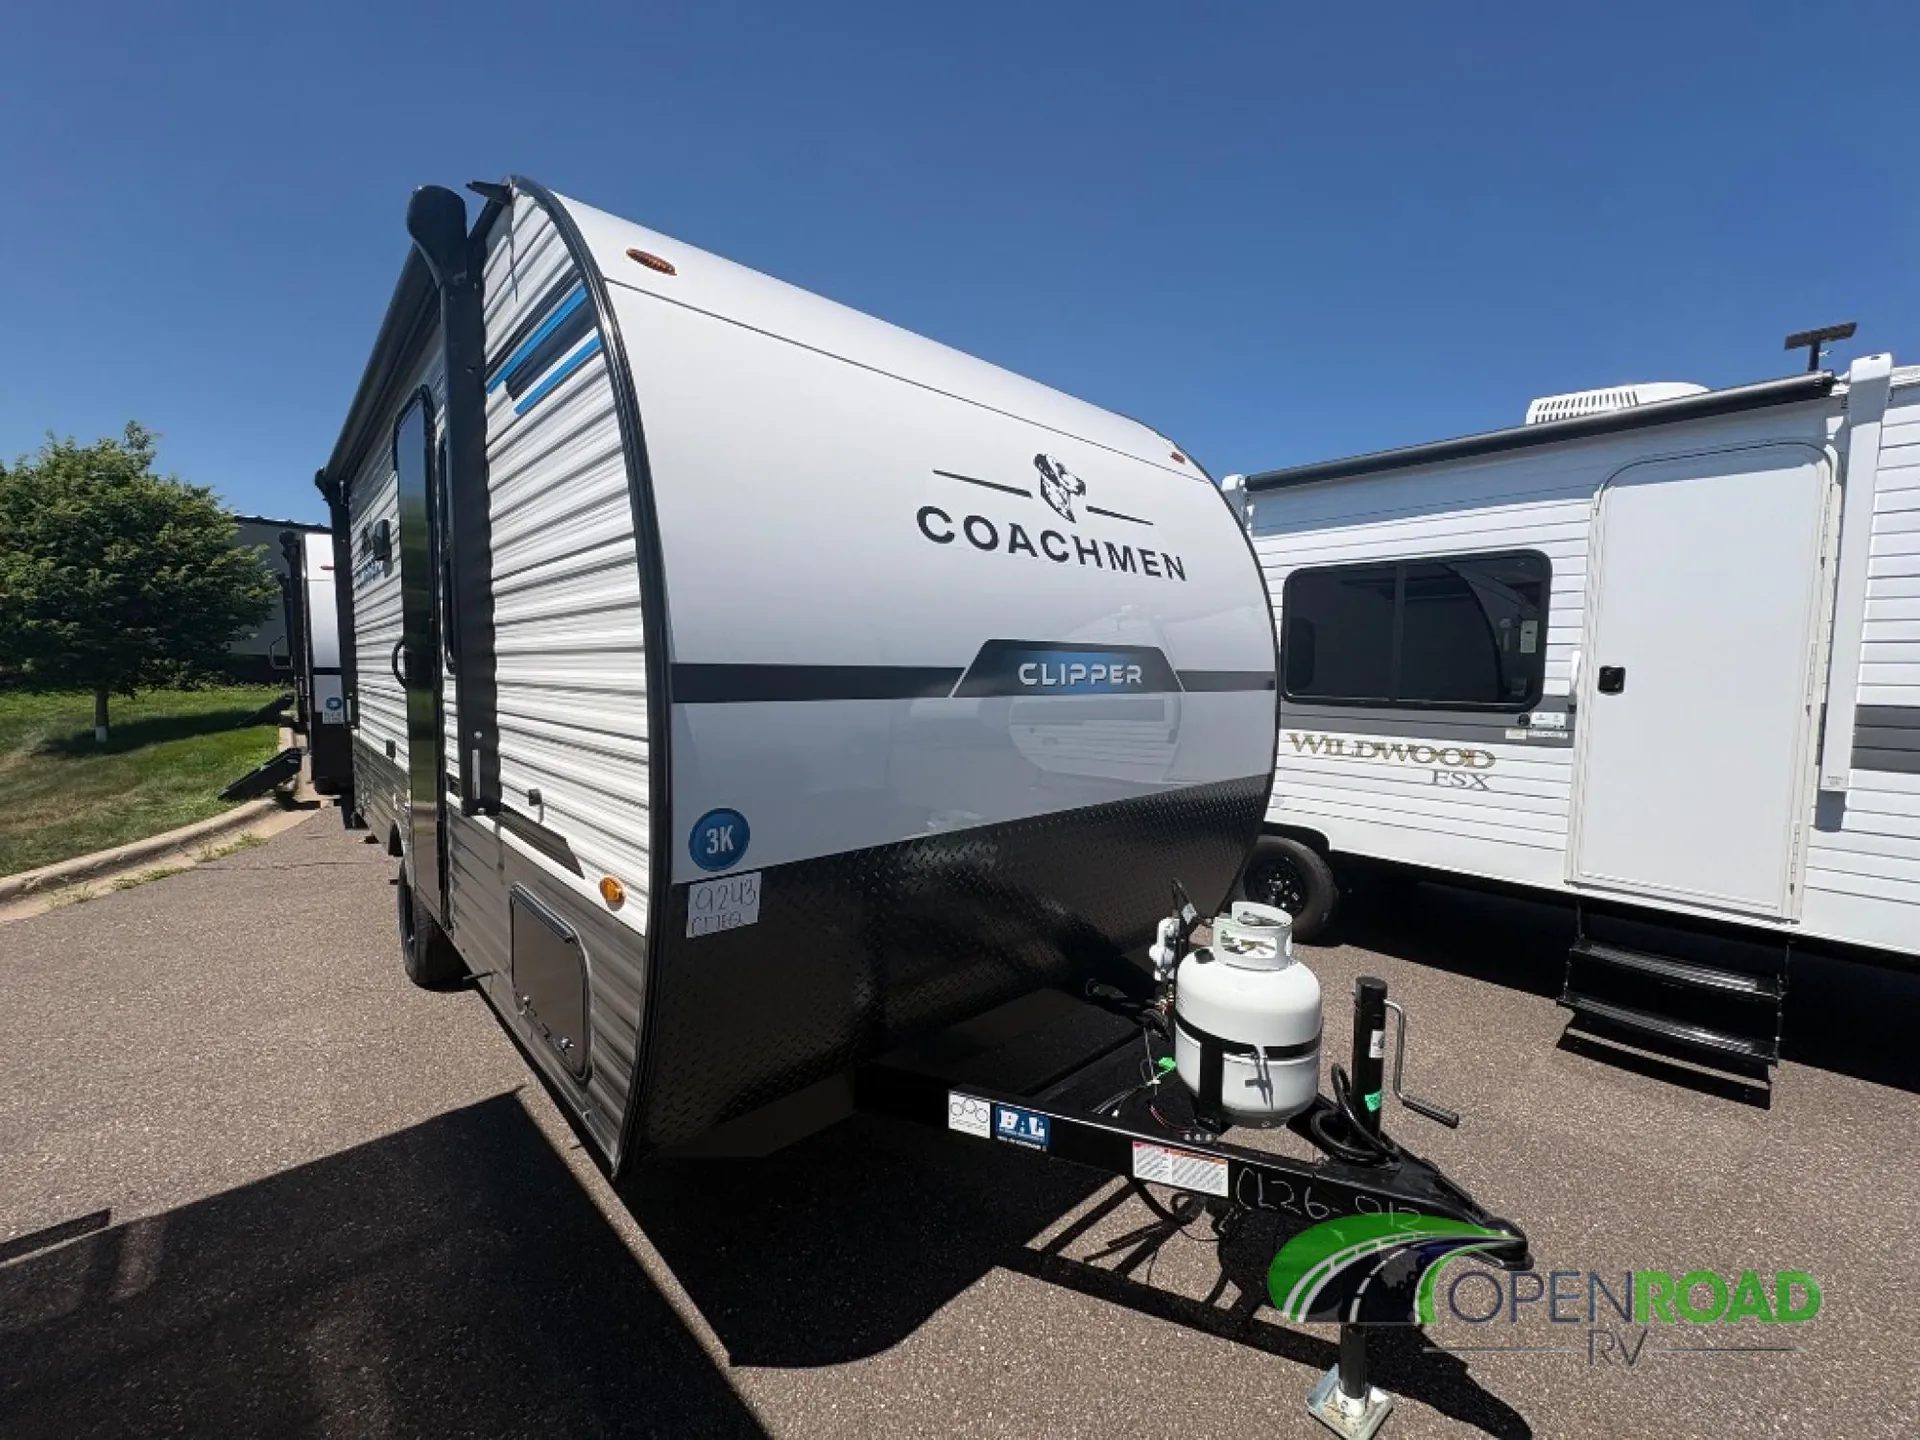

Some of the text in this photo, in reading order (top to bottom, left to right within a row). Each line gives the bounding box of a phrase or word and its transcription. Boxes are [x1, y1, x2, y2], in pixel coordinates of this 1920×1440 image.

[916, 505, 1187, 581] COACHMEN
[1018, 662, 1143, 686] CLIPPER
[1287, 732, 1497, 769] WILDWOOD
[1432, 769, 1491, 792] FSX
[706, 825, 734, 854] 3K
[695, 878, 757, 913] 9243
